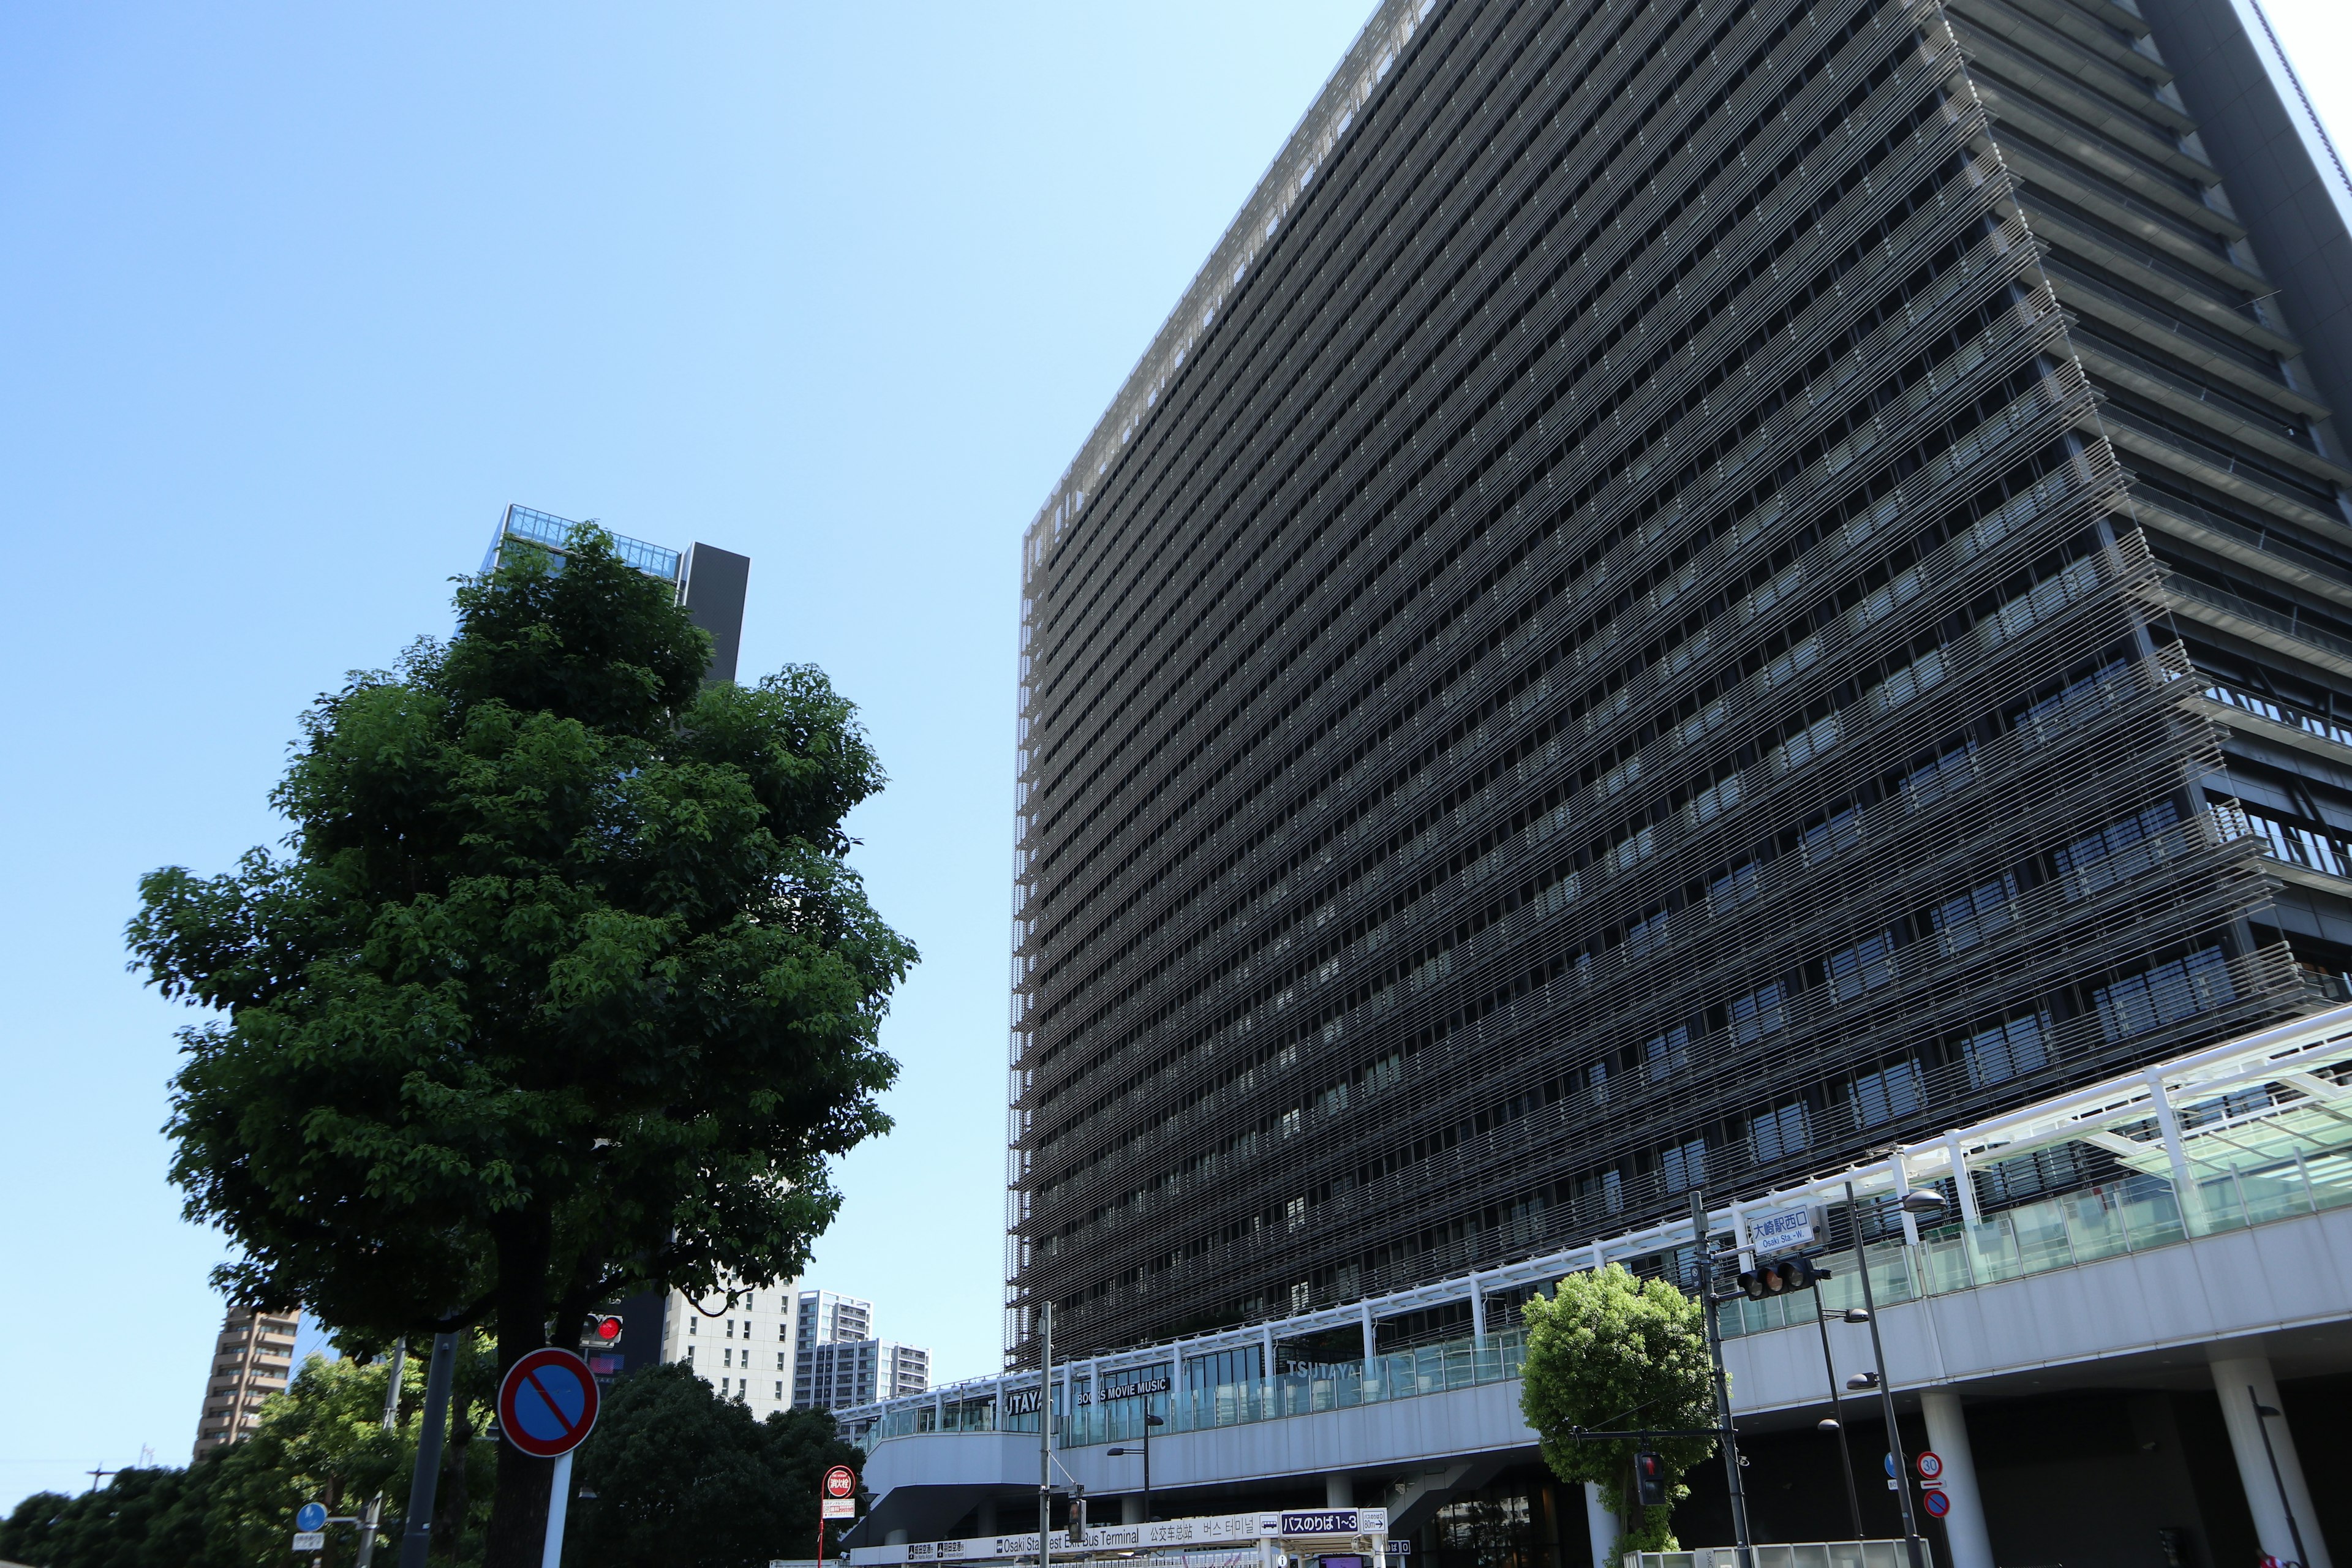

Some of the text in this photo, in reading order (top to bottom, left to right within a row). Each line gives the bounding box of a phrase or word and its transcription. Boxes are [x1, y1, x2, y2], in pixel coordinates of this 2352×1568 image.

[1754, 1211, 1807, 1239] 大崎駅西口
[1763, 1237, 1779, 1248] Osaki
[1287, 1360, 1358, 1381] TSUTAYA
[1077, 1379, 1166, 1404] BOS MOVIE MUSIC
[1923, 1459, 1937, 1471] 30
[830, 1478, 849, 1488] 消火栓
[1365, 1520, 1375, 1529] 80m
[1150, 1523, 1193, 1542] 公交车总站
[1004, 1537, 1025, 1553] Osaki
[1049, 1535, 1061, 1550] est
[1083, 1532, 1099, 1547] Bus
[1100, 1528, 1139, 1545] Terminal
[914, 1544, 933, 1554] 成田空港行
[944, 1542, 964, 1553] 羽田空港行
